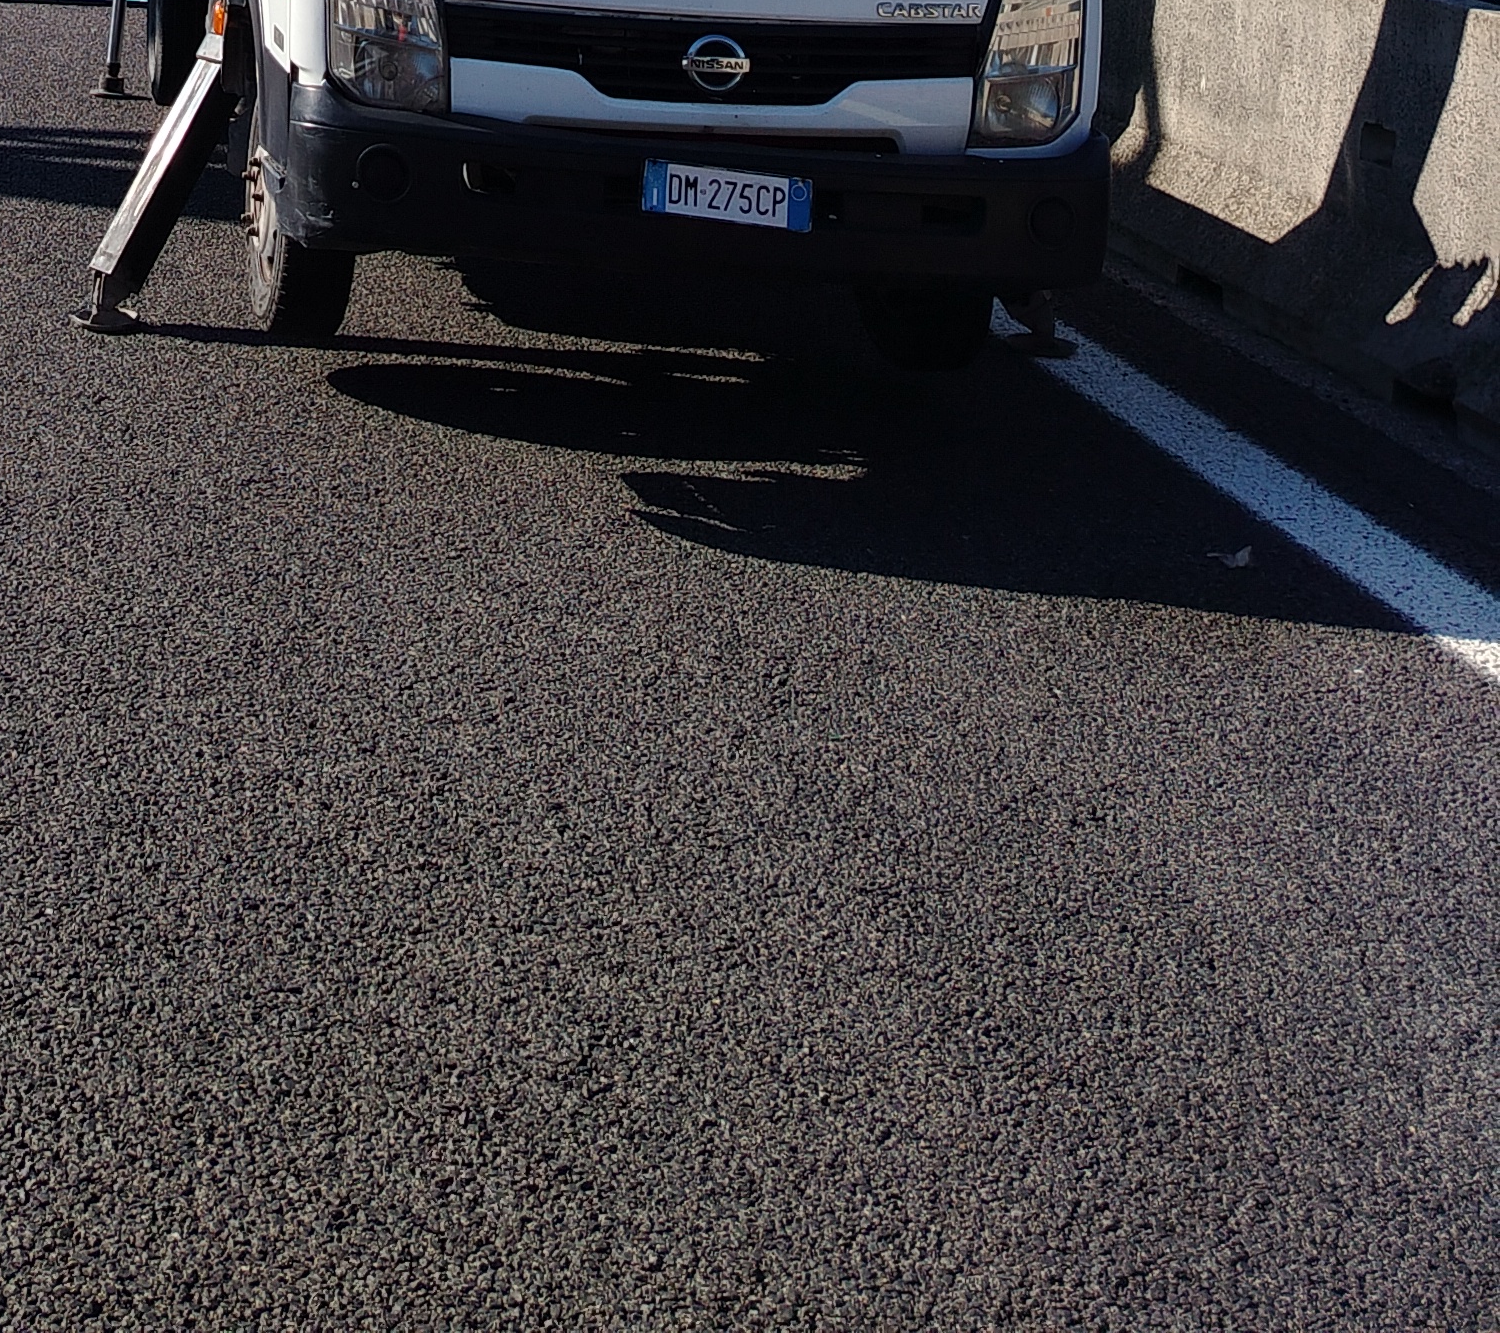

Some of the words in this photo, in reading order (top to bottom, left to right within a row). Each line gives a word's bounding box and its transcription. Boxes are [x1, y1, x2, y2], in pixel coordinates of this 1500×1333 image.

[876, 1, 983, 19] CABSTAR
[690, 58, 745, 71] NISSAN
[668, 173, 699, 207] DM
[707, 178, 786, 218] 275CP
